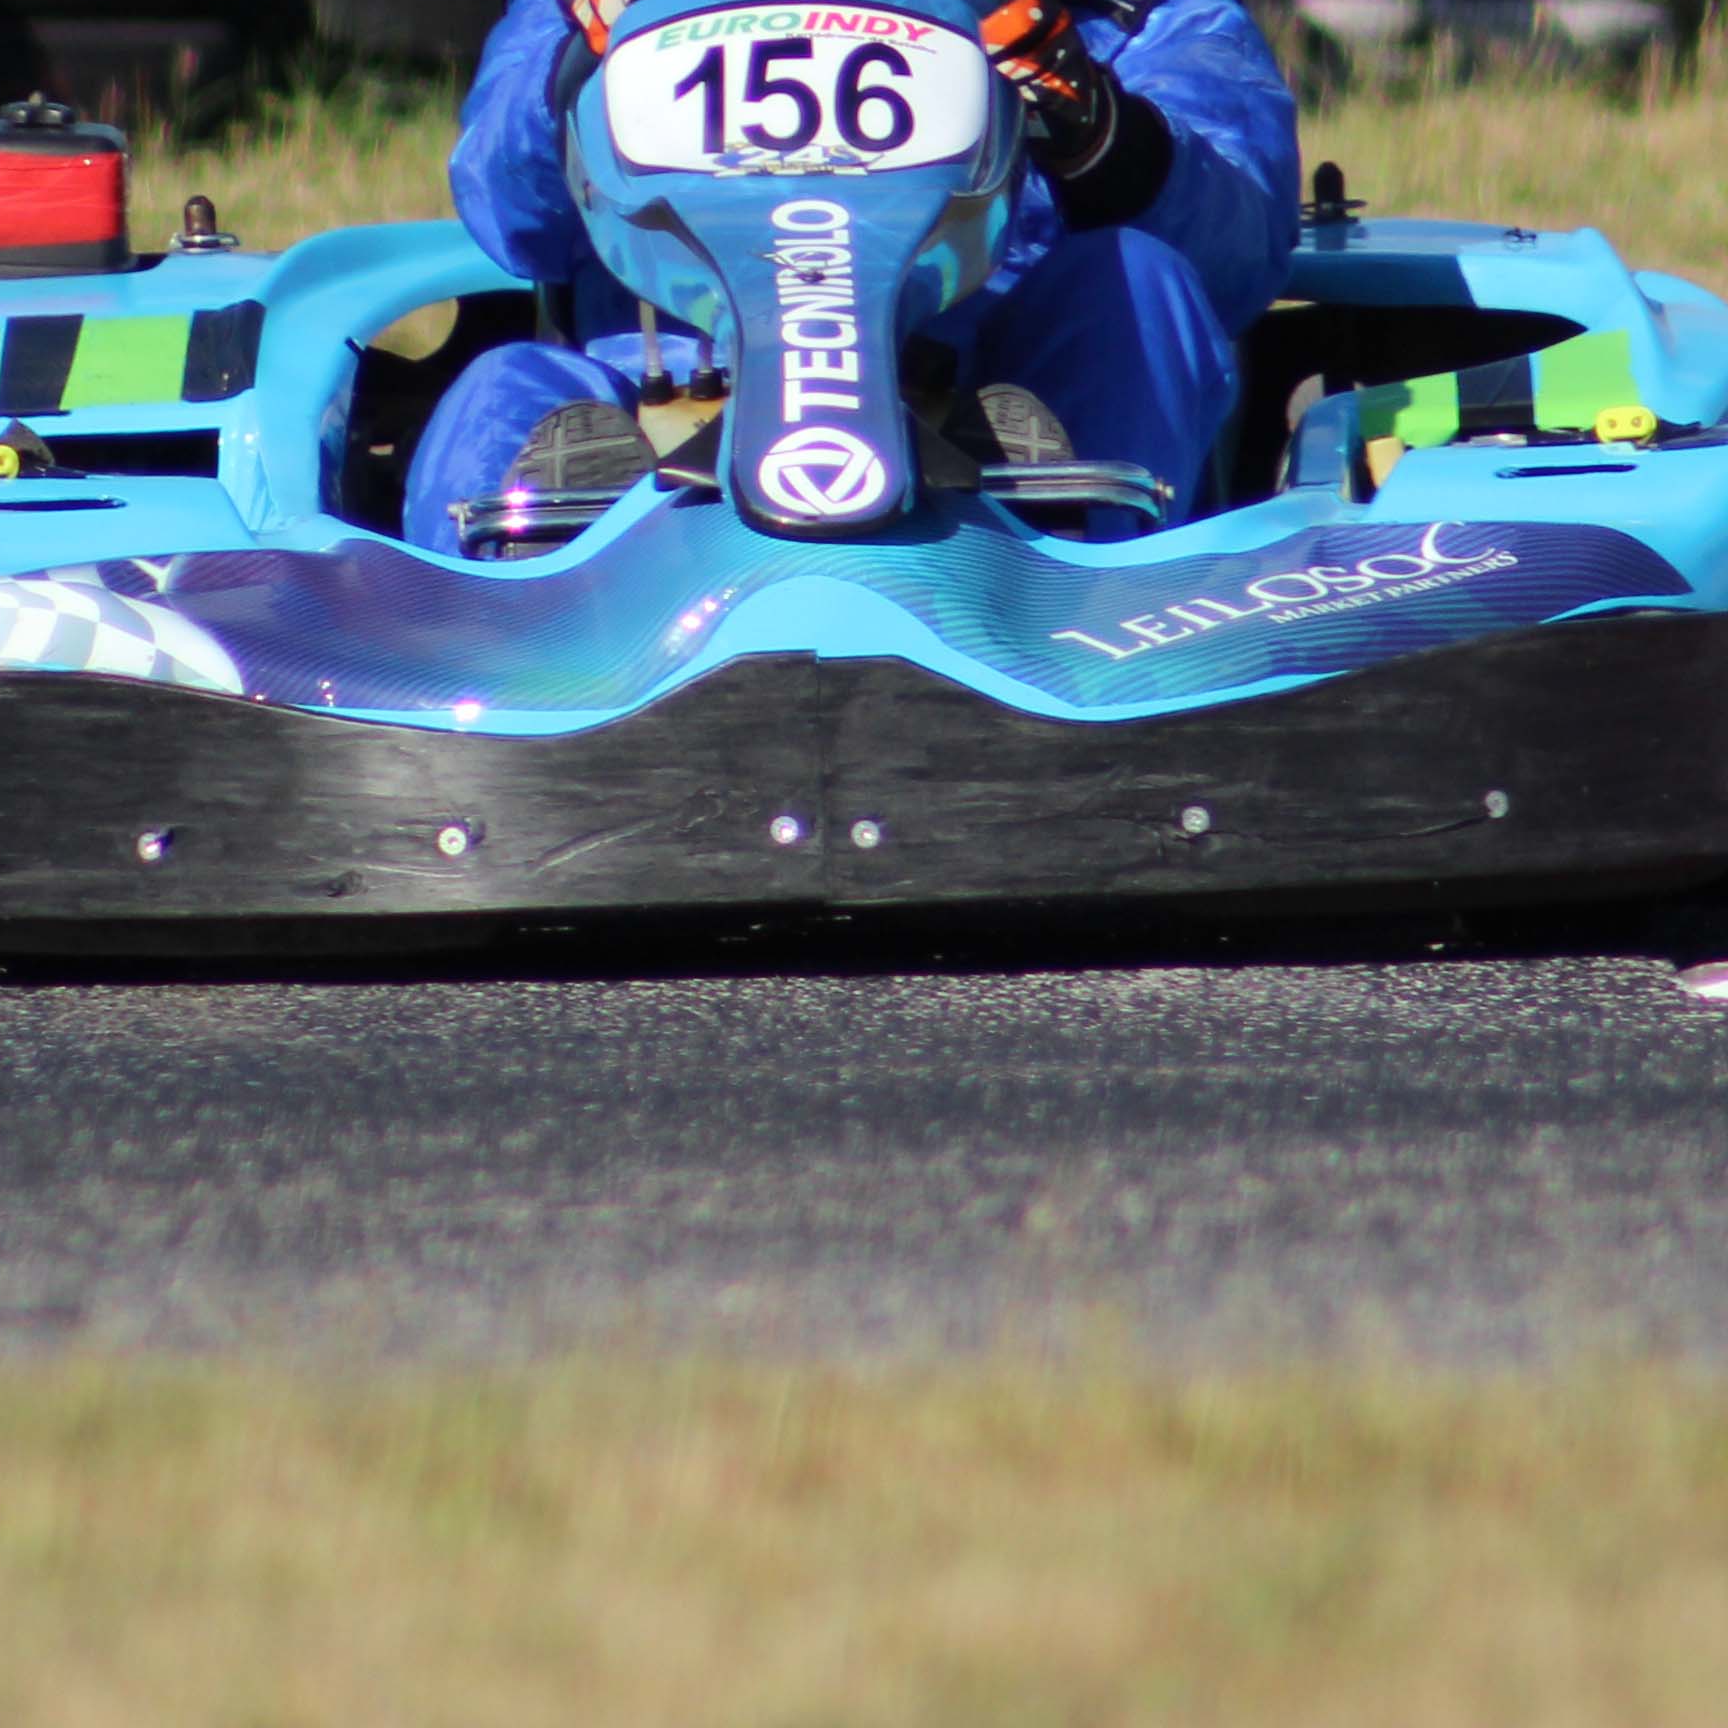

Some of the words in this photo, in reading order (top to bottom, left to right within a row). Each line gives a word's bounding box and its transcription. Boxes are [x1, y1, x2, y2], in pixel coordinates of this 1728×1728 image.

[656, 11, 936, 51] EUROINDY
[674, 36, 915, 154] 156
[771, 199, 860, 423] TECNIROLO
[1050, 520, 1497, 661] LEILOSOC
[1268, 591, 1384, 624] MARKET
[1384, 551, 1519, 599] PARTNERS
